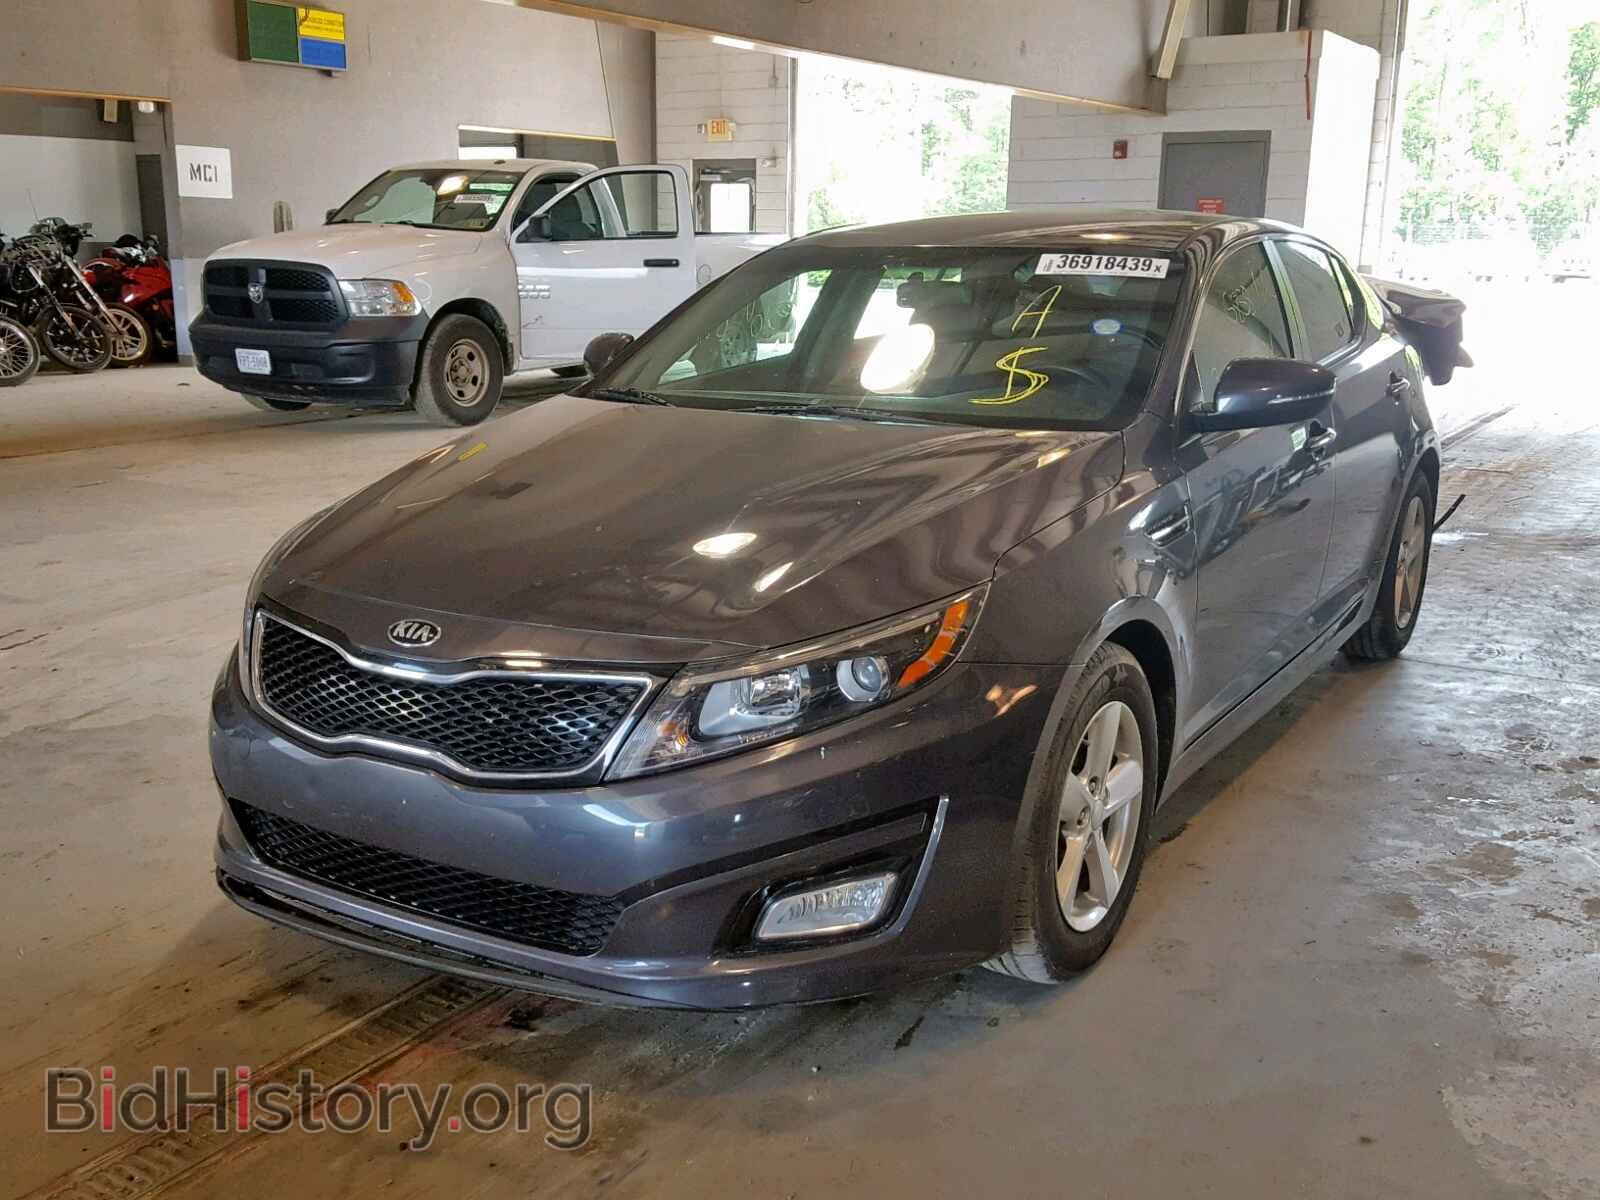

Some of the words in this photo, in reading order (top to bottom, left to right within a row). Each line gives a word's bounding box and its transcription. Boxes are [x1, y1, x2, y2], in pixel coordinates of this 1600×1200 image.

[711, 119, 726, 136] EXIT
[1056, 254, 1154, 272] 36918439
[393, 621, 433, 642] KIA
